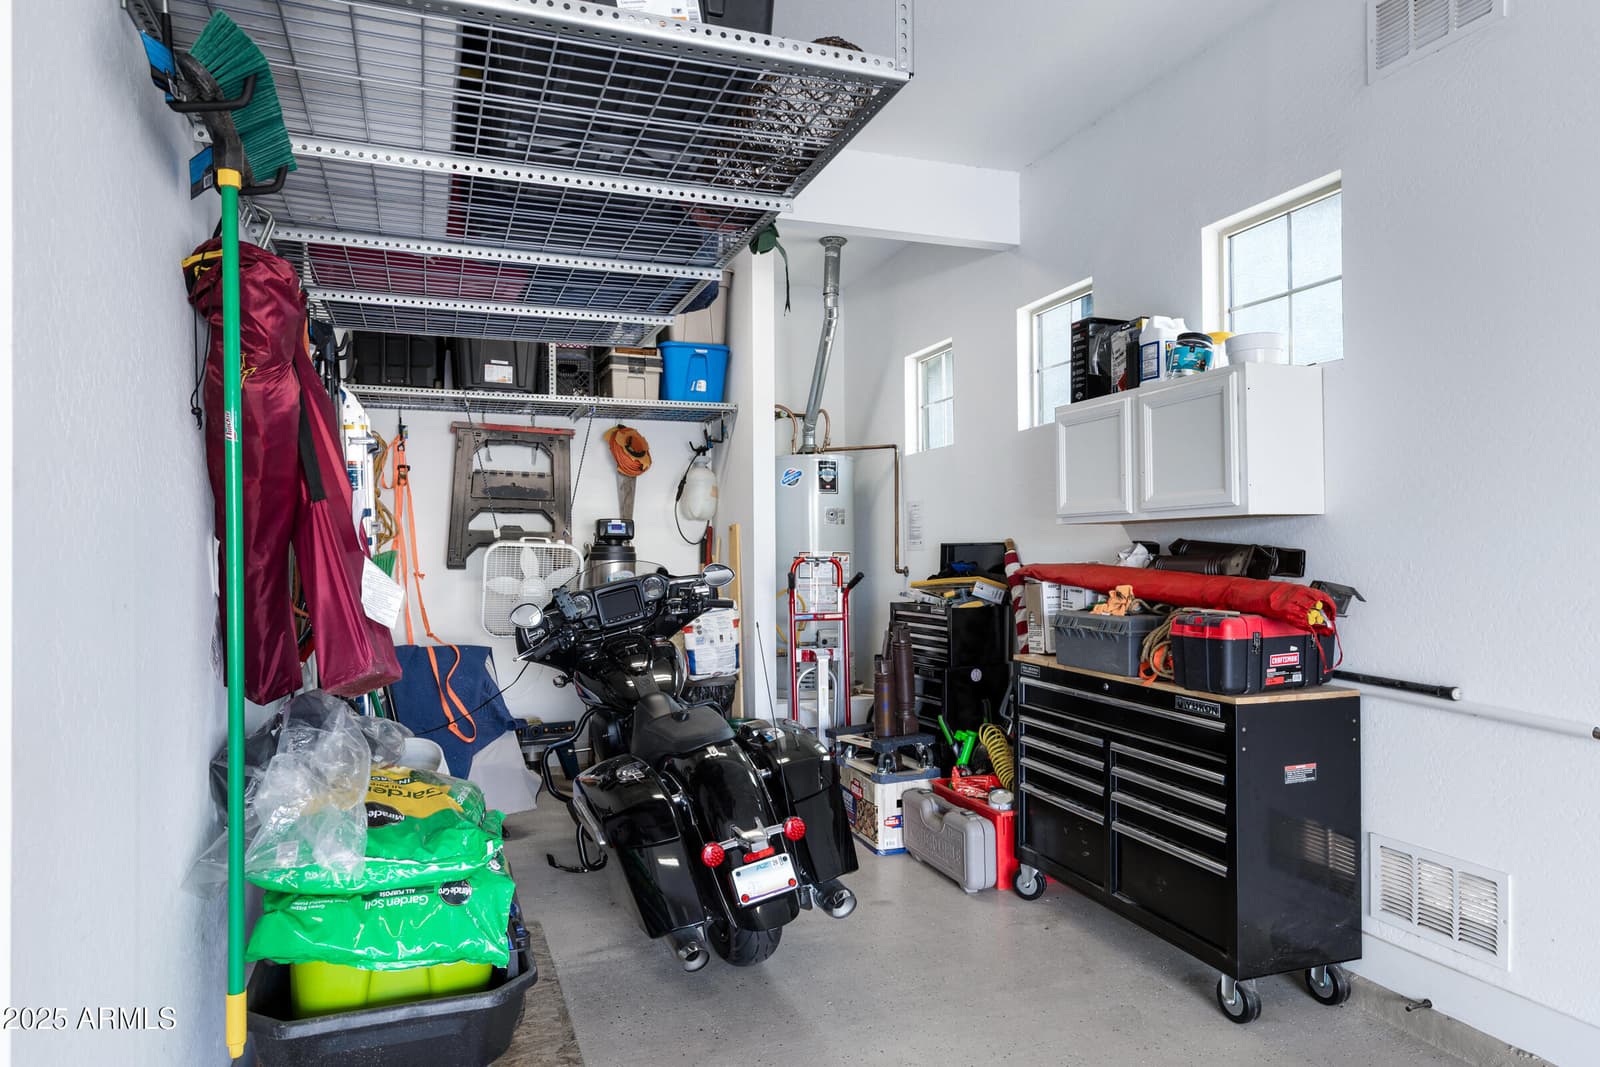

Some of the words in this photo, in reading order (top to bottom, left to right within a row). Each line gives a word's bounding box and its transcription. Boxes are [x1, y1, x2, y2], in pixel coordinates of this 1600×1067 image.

[379, 889, 405, 898] PURPOSE
[438, 886, 473, 896] Miracle-Gro
[364, 898, 385, 910] Soil
[386, 895, 429, 907] Garden
